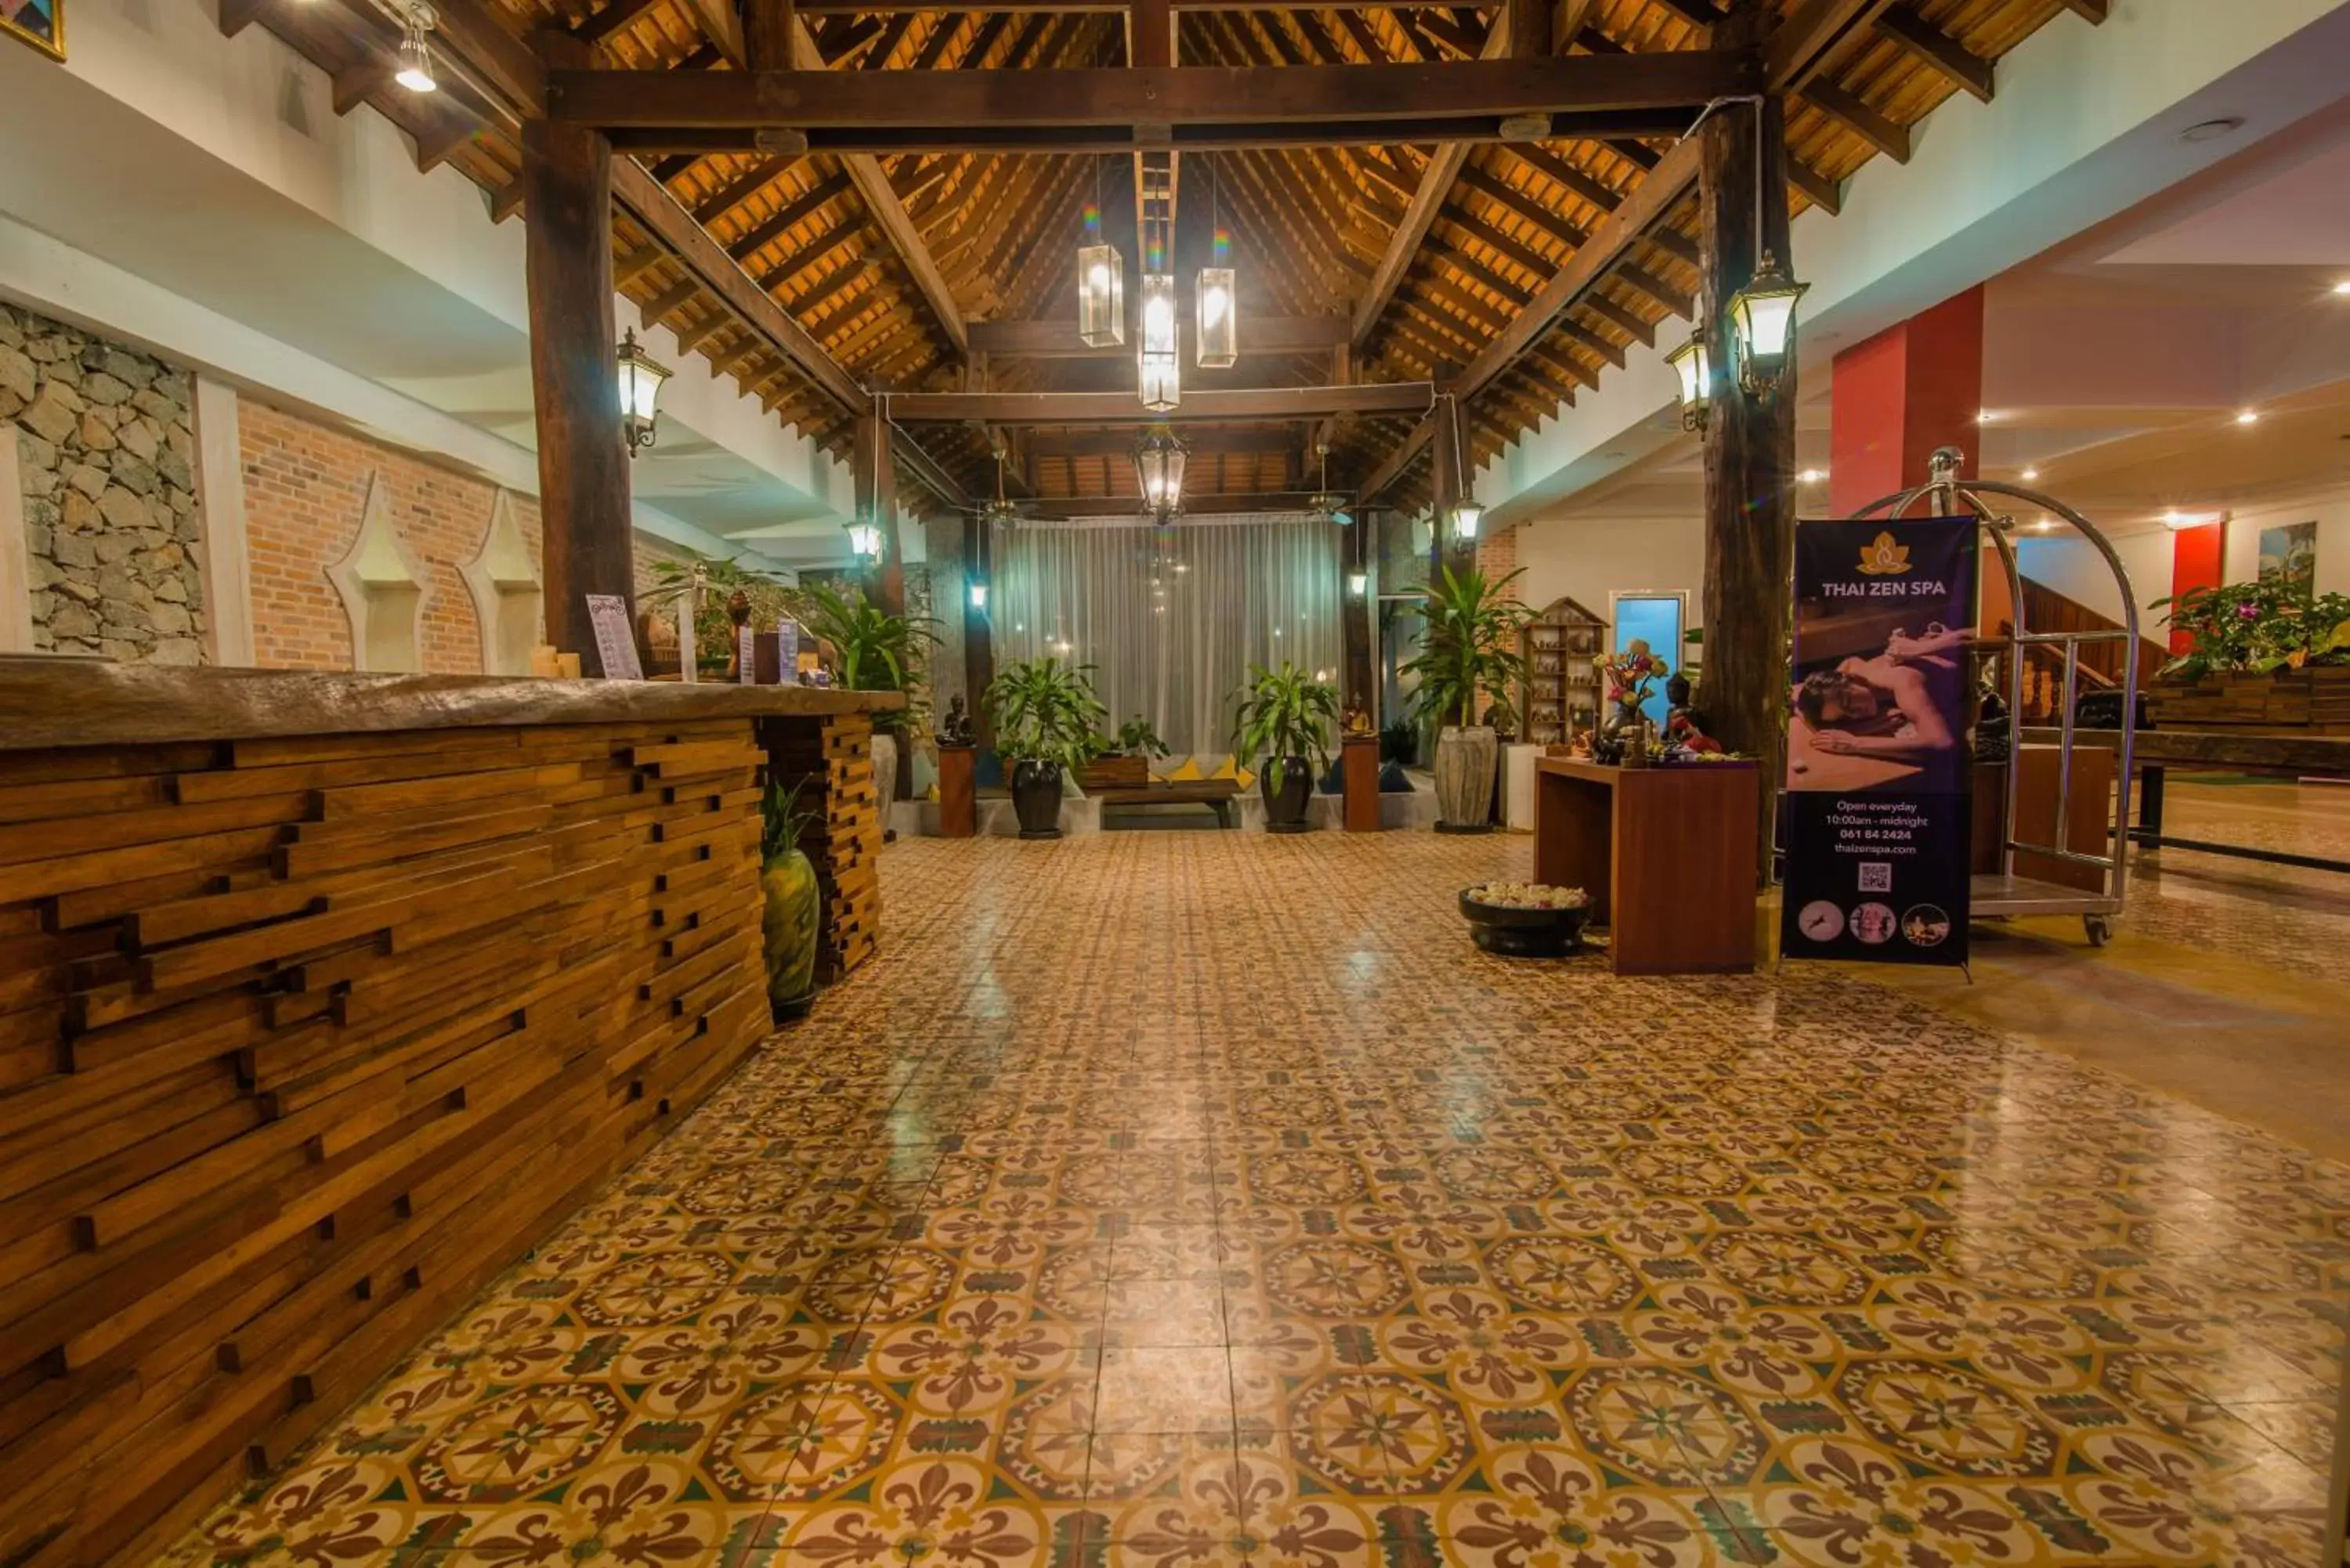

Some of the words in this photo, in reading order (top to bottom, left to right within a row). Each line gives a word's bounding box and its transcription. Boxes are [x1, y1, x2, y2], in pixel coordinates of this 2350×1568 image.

[1822, 583, 1864, 596] THAI
[1869, 582, 1906, 596] ZEN
[1910, 580, 1947, 595] SPA
[1837, 800, 1866, 812] Open
[1869, 802, 1917, 813] everyday
[1826, 815, 1871, 825] 10:00am
[1880, 816, 1928, 828] midnight
[1840, 829, 1860, 839] 061
[1865, 829, 1879, 839] 84
[1882, 830, 1911, 840] 2424
[1835, 843, 1916, 855] thaizenspa.com
